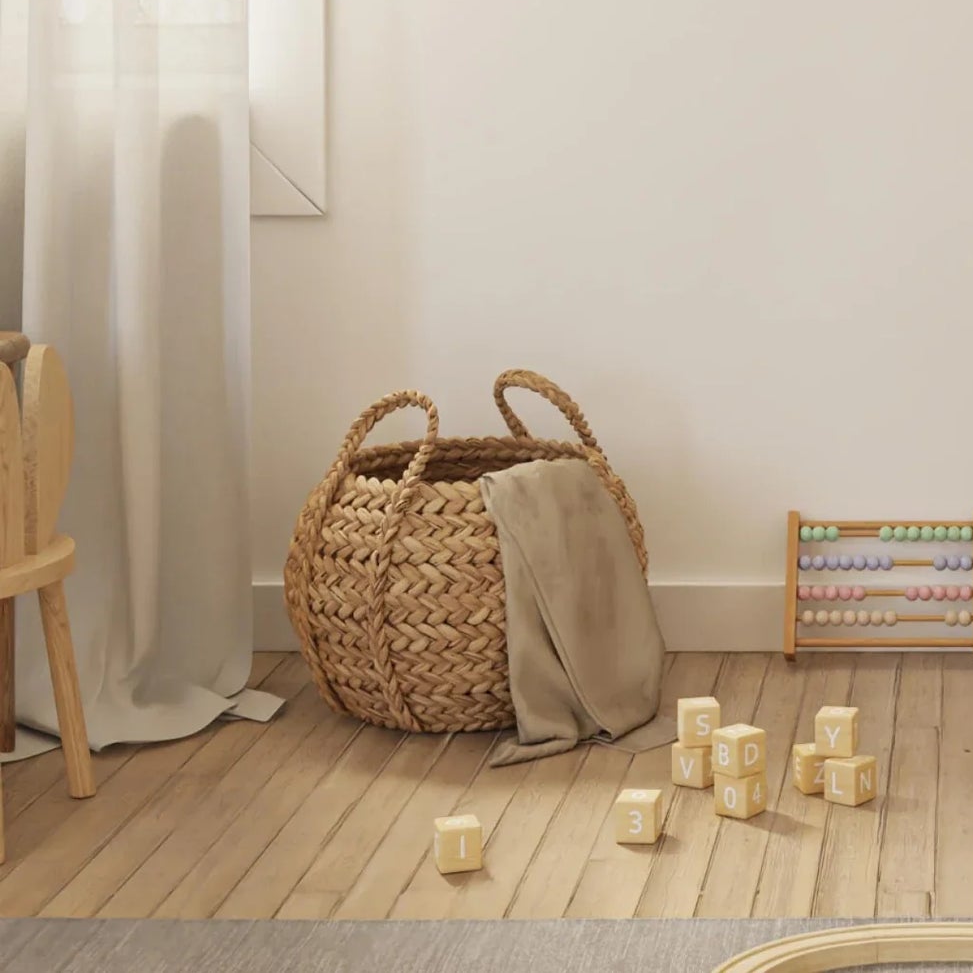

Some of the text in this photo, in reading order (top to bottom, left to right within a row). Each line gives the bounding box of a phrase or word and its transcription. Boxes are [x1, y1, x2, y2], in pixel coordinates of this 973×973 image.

[696, 714, 711, 736] S
[824, 726, 841, 749] Y
[718, 743, 730, 766] B
[744, 743, 759, 766] D
[679, 756, 695, 779] V
[831, 771, 843, 795] L
[860, 770, 872, 794] N
[628, 810, 643, 835] 3
